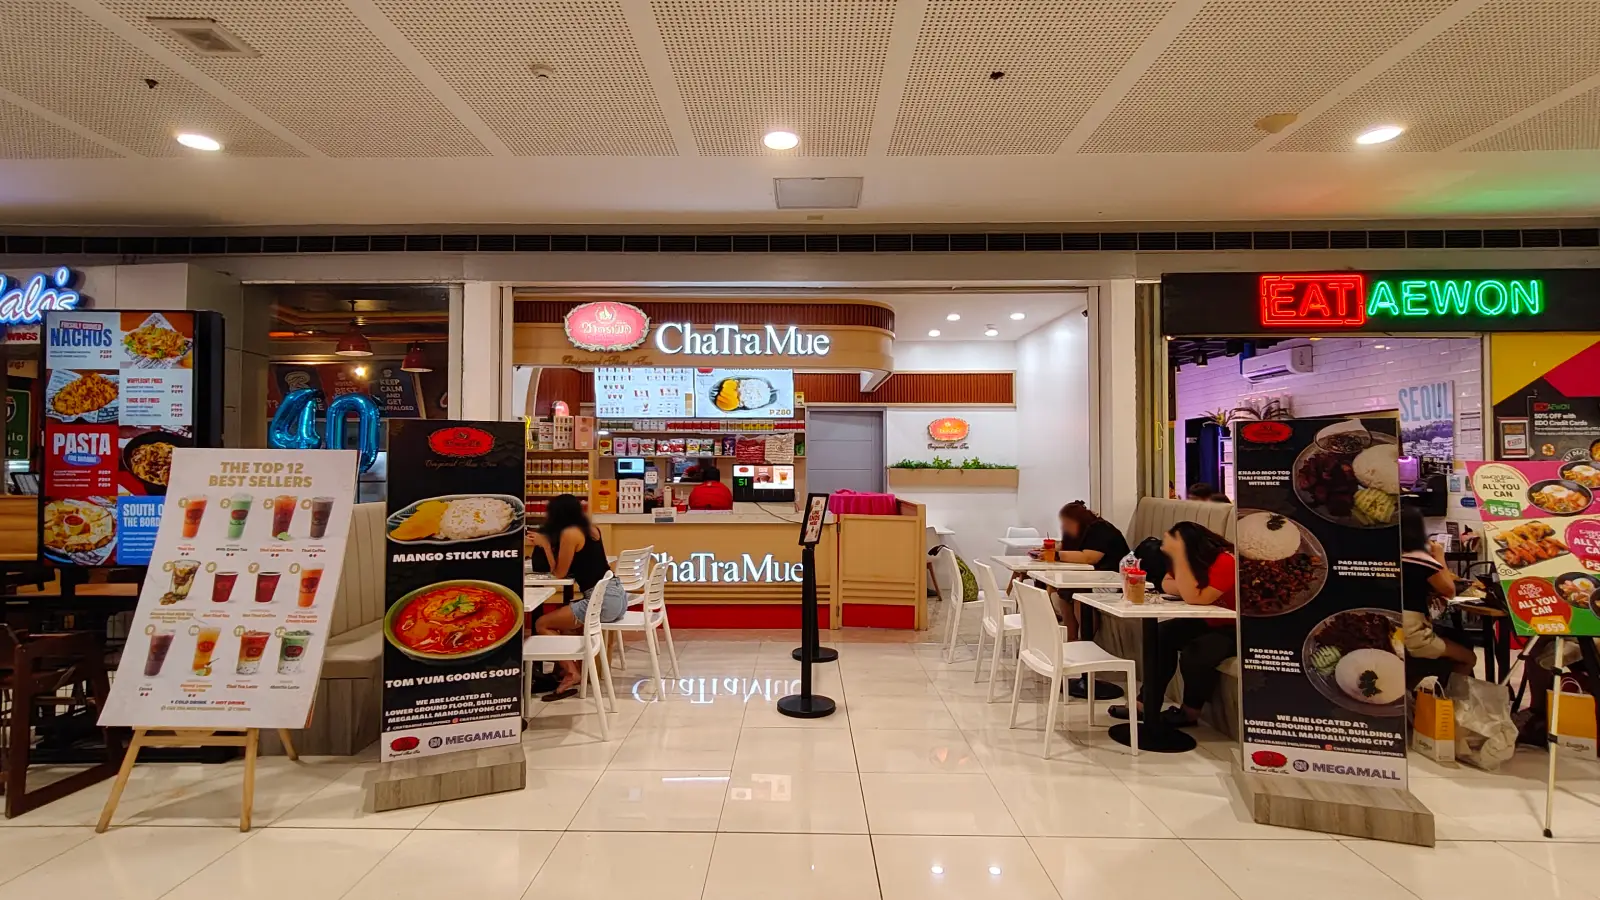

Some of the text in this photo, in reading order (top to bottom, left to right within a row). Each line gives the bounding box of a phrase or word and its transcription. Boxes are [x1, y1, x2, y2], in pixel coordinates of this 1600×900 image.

[50, 328, 112, 346] NACHOS
[1399, 382, 1453, 422] SEOUL
[54, 433, 111, 454] PASTA
[220, 462, 304, 474] THE TOP 12
[209, 476, 312, 487] BEST SELLERS
[123, 504, 155, 516] SOUTH
[123, 517, 138, 527] THE
[1574, 538, 1593, 546] ALL
[393, 549, 518, 563] MANGO STICKY RICE
[1518, 596, 1558, 609] ALL YOU
[1531, 606, 1553, 615] CAN
[386, 668, 520, 688] TOM YUM GOONG SOUP
[446, 694, 479, 702] LOCATED
[385, 708, 414, 716] LOWER
[415, 704, 448, 712] GROUND
[477, 697, 511, 706] BUILDING
[388, 714, 433, 723] MEGAMALL
[434, 707, 495, 717] MANDALUYONG
[1311, 718, 1351, 727] LOCATED
[445, 729, 516, 745] MEGAMALL
[1248, 727, 1297, 737] MEGAMALL
[1299, 732, 1372, 744] MANDALUYONG
[1276, 722, 1313, 731] GROUND
[1349, 729, 1393, 738] BUILDING
[1313, 762, 1400, 780] MEGAMALL
